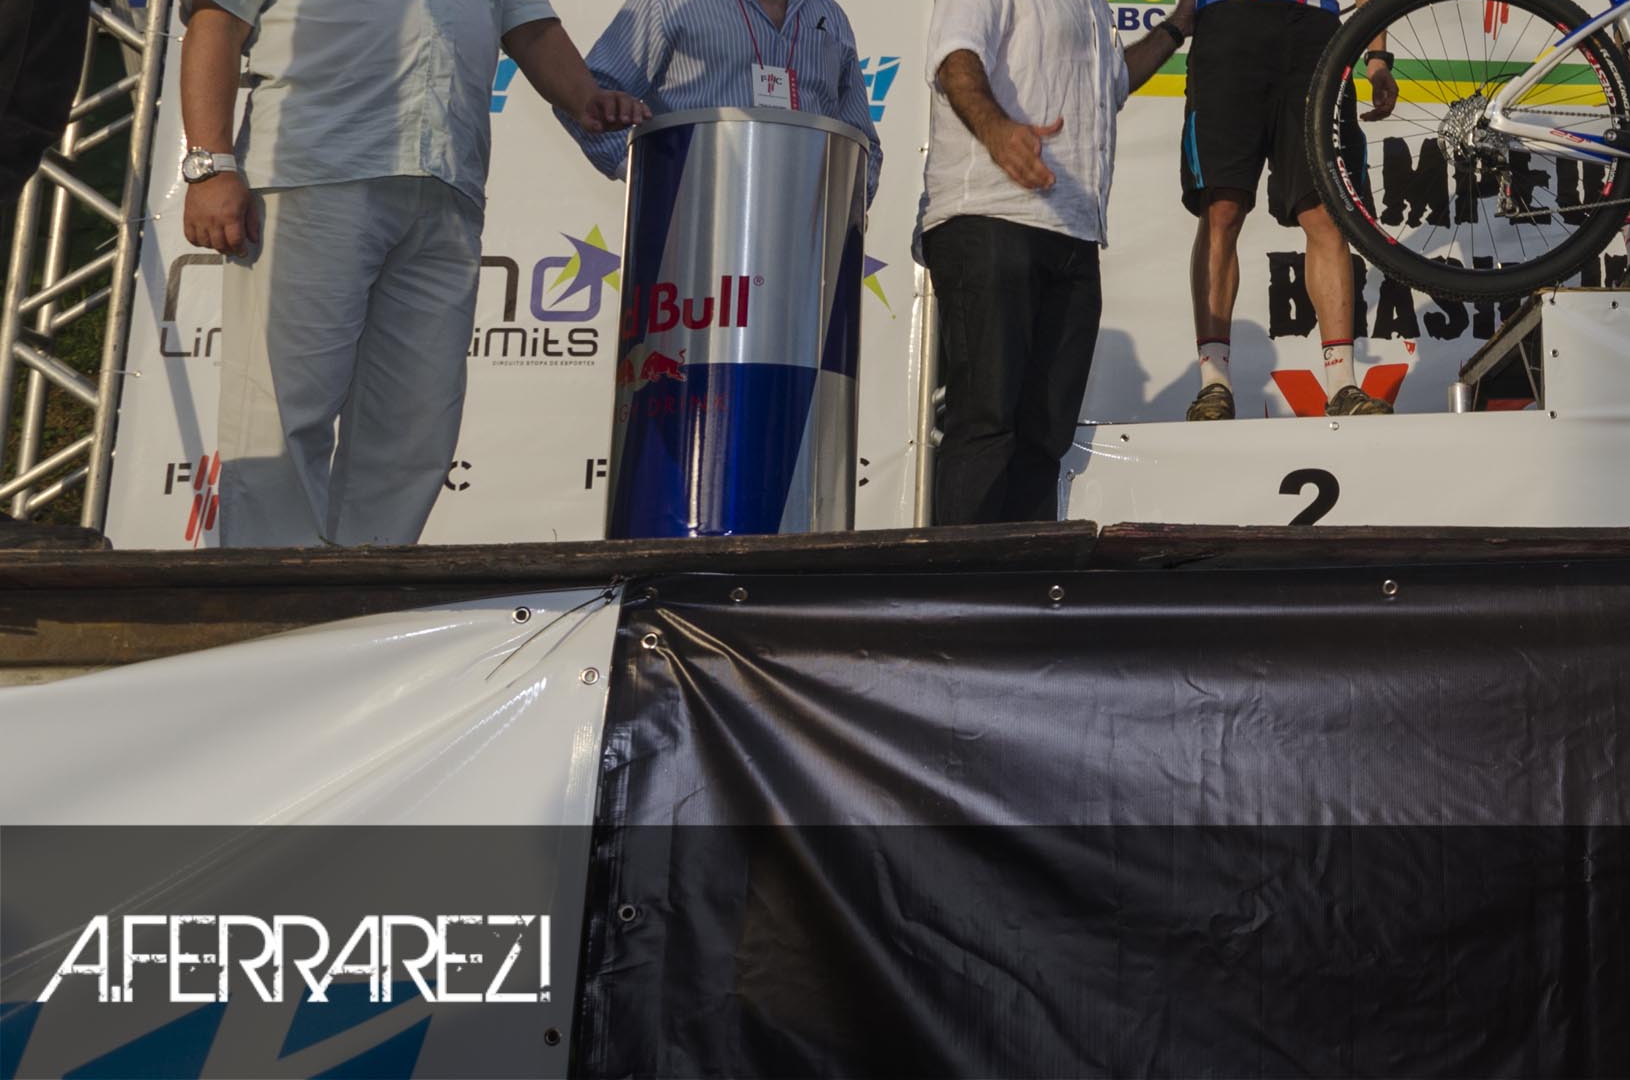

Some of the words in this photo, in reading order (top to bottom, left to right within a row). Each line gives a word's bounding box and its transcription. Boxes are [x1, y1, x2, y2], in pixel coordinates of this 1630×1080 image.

[1114, 6, 1167, 32] BC
[648, 275, 750, 334] Bull
[467, 327, 600, 358] imits
[1278, 468, 1340, 527] 2
